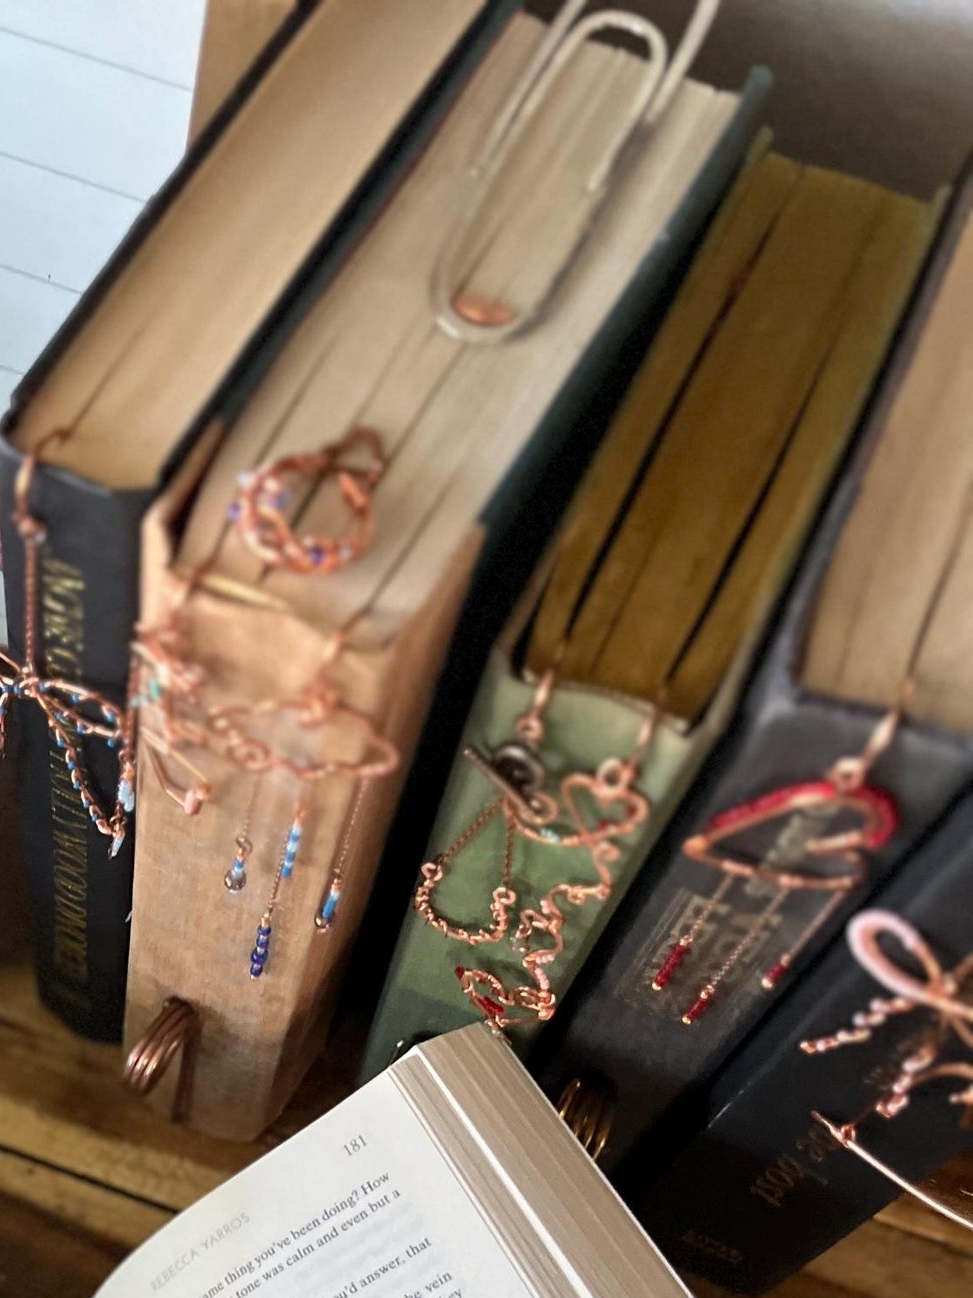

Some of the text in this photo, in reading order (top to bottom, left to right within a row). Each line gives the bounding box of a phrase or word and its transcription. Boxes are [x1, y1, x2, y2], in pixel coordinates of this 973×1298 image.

[342, 1133, 367, 1156] 181
[148, 1210, 251, 1291] REBECCA YARROS
[224, 1260, 256, 1286] thing
[253, 1236, 292, 1268] you've
[289, 1217, 322, 1241] been
[321, 1189, 360, 1222] doing?
[360, 1171, 390, 1196] How
[359, 1255, 407, 1288] answer,
[405, 1237, 432, 1259] that
[424, 1271, 454, 1293] vein
